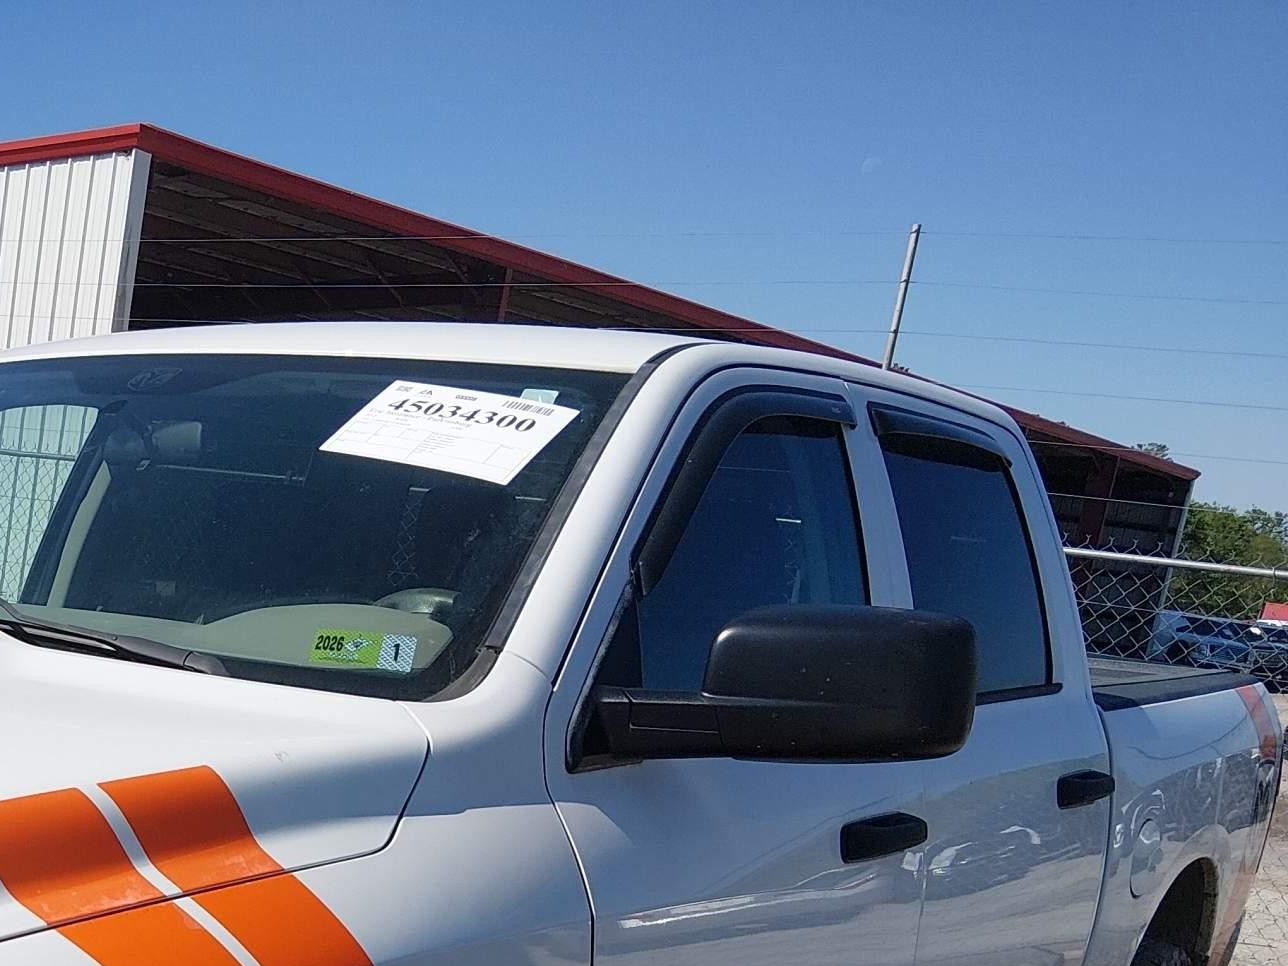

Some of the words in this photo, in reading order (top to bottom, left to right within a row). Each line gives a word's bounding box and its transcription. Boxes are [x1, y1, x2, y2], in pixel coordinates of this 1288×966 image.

[388, 398, 537, 432] 45034300
[314, 634, 345, 652] 2026
[393, 643, 400, 662] 1
